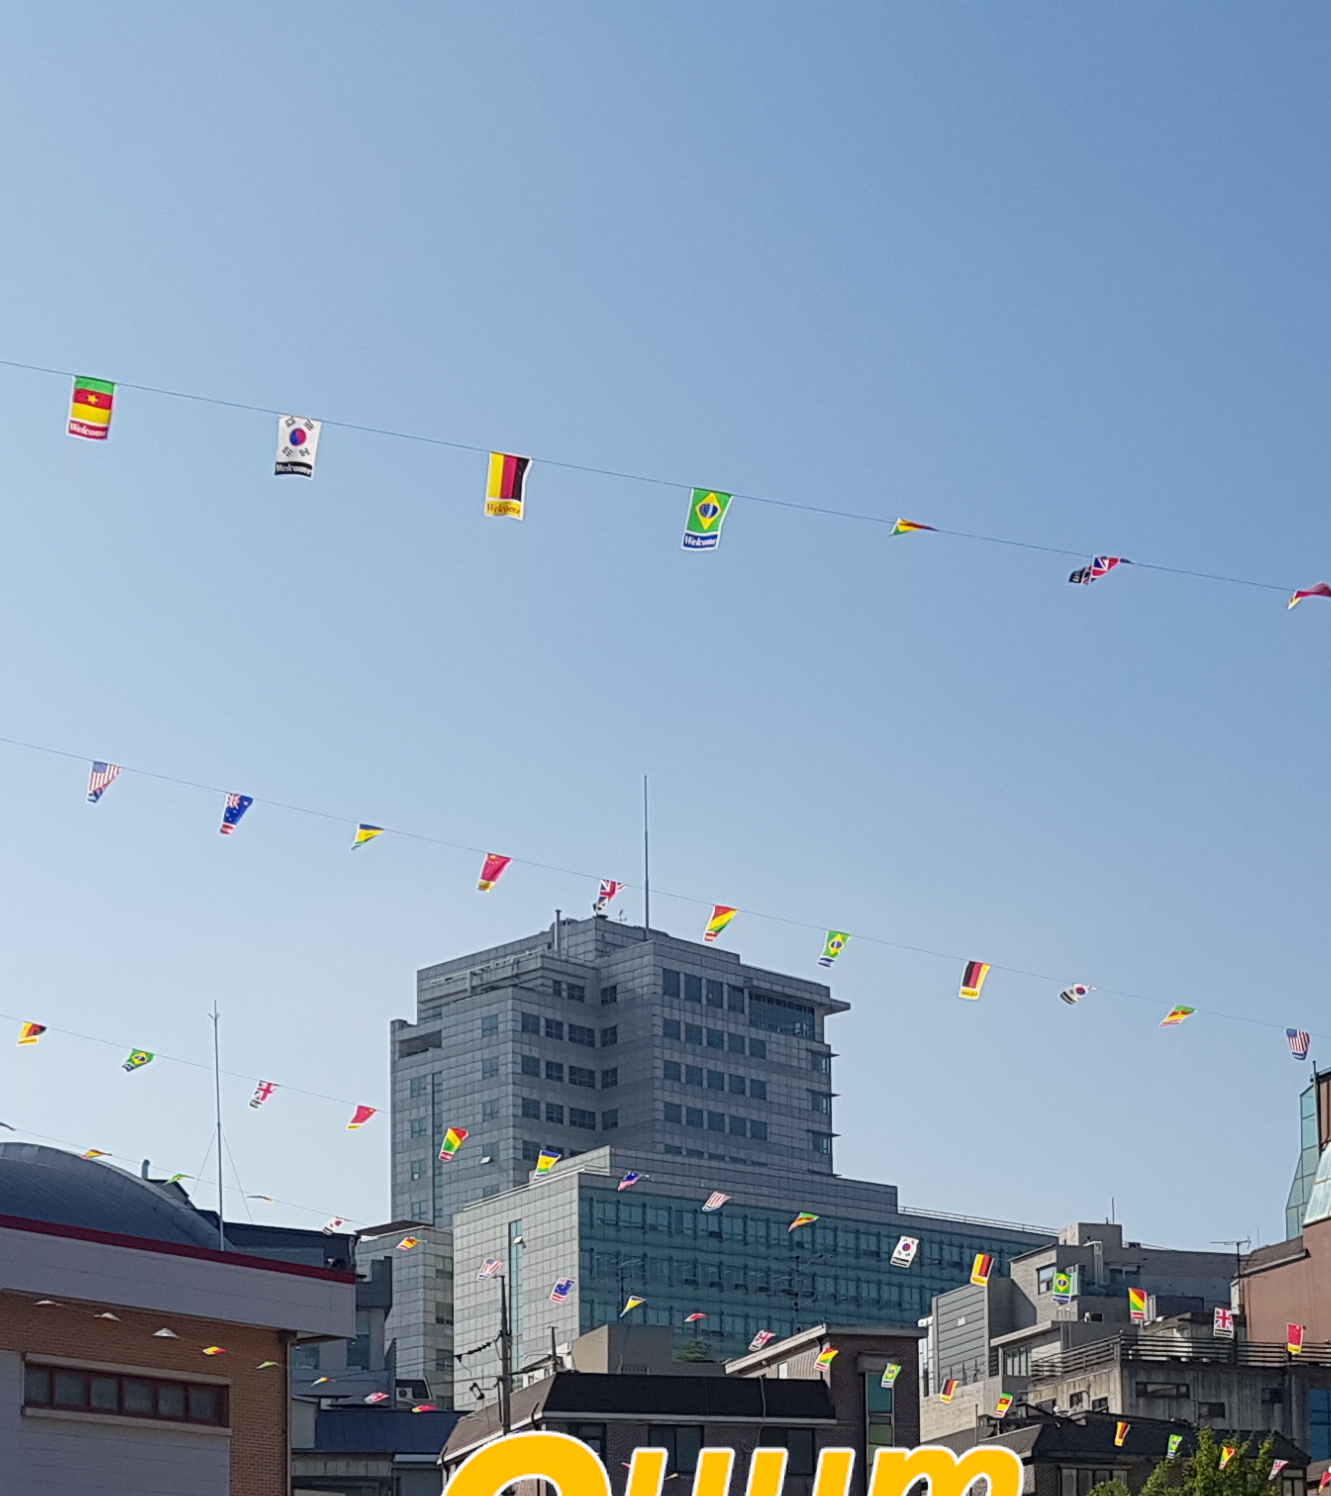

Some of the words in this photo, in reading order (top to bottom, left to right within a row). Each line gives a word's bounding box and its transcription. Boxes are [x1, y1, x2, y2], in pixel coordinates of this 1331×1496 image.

[69, 421, 107, 438] Welcome
[276, 463, 312, 475] Welcome
[684, 534, 717, 546] Welcome
